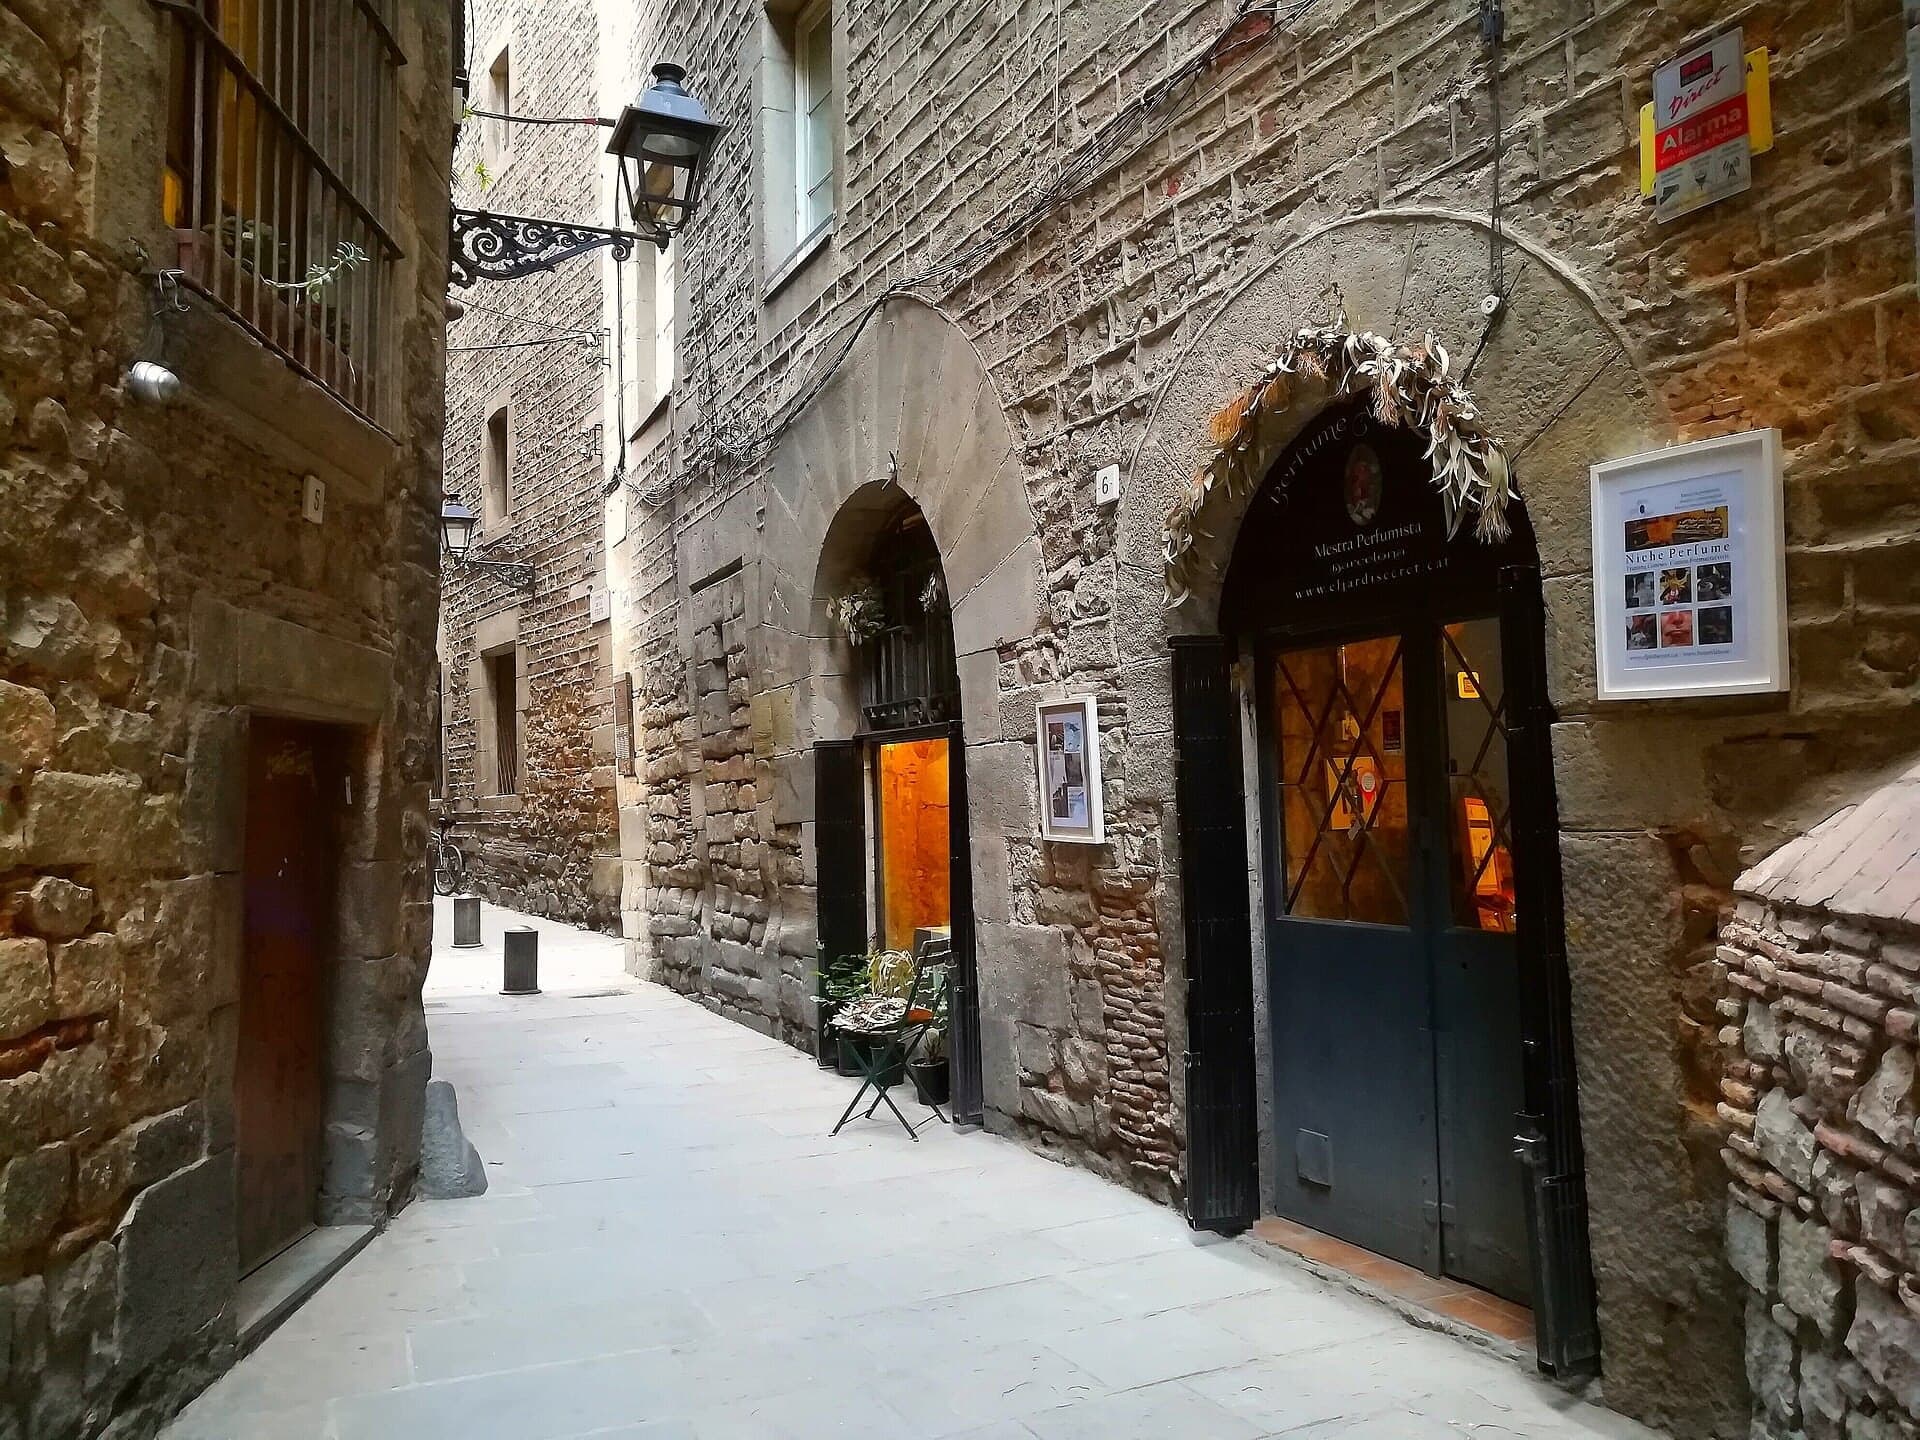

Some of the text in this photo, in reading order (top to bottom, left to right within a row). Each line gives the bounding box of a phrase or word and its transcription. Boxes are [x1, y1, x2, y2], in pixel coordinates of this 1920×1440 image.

[1668, 63, 1730, 120] Direct
[1661, 105, 1743, 154] Alarma
[1102, 475, 1109, 495] 6
[1356, 521, 1422, 549] Perfumista
[1624, 549, 1664, 565] Niche
[1668, 542, 1731, 559] Perfume
